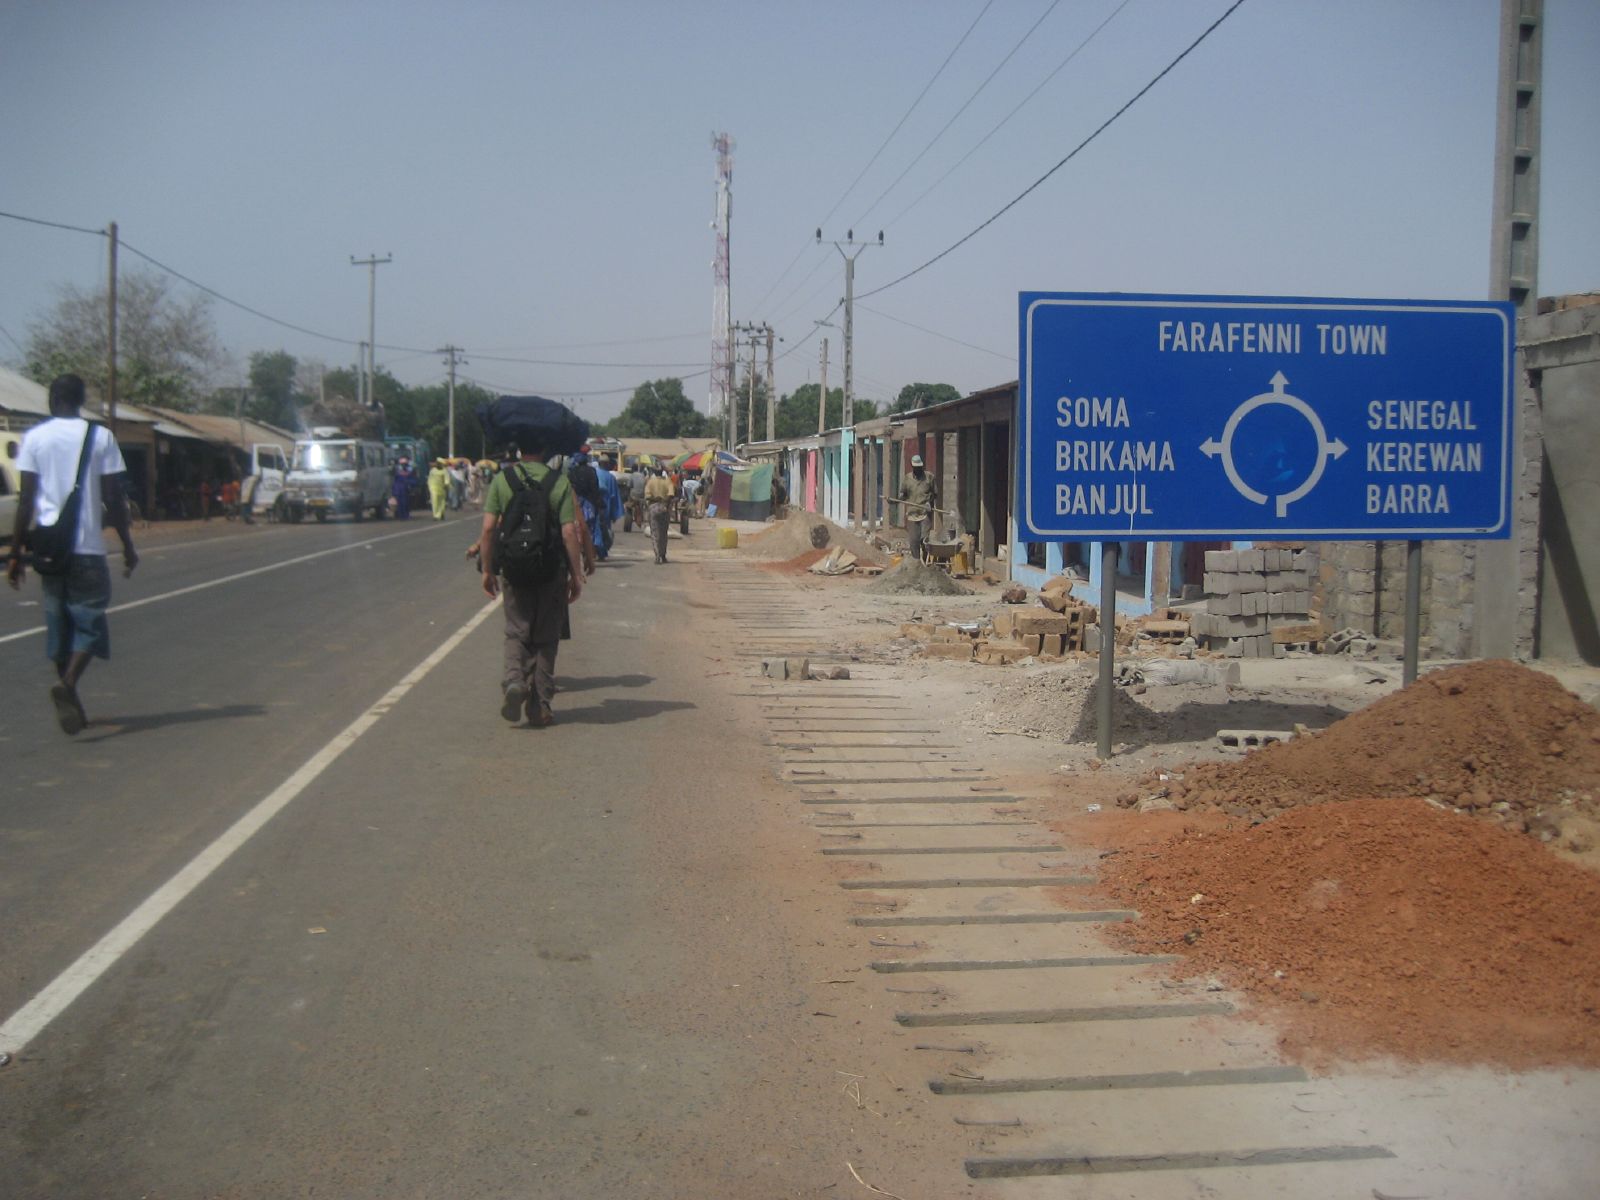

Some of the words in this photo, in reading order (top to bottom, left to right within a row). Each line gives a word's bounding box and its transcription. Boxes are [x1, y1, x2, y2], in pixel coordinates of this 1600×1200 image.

[1160, 322, 1300, 353] FARAFENNI
[1317, 325, 1386, 354] TOWN
[1057, 397, 1129, 427] SOMA
[1368, 401, 1476, 430] SENEGAL
[1056, 441, 1174, 471] BRIKAMA
[1368, 443, 1480, 471] KEREWAN
[1056, 484, 1153, 514] BANJUL
[1367, 485, 1448, 513] BARRA
